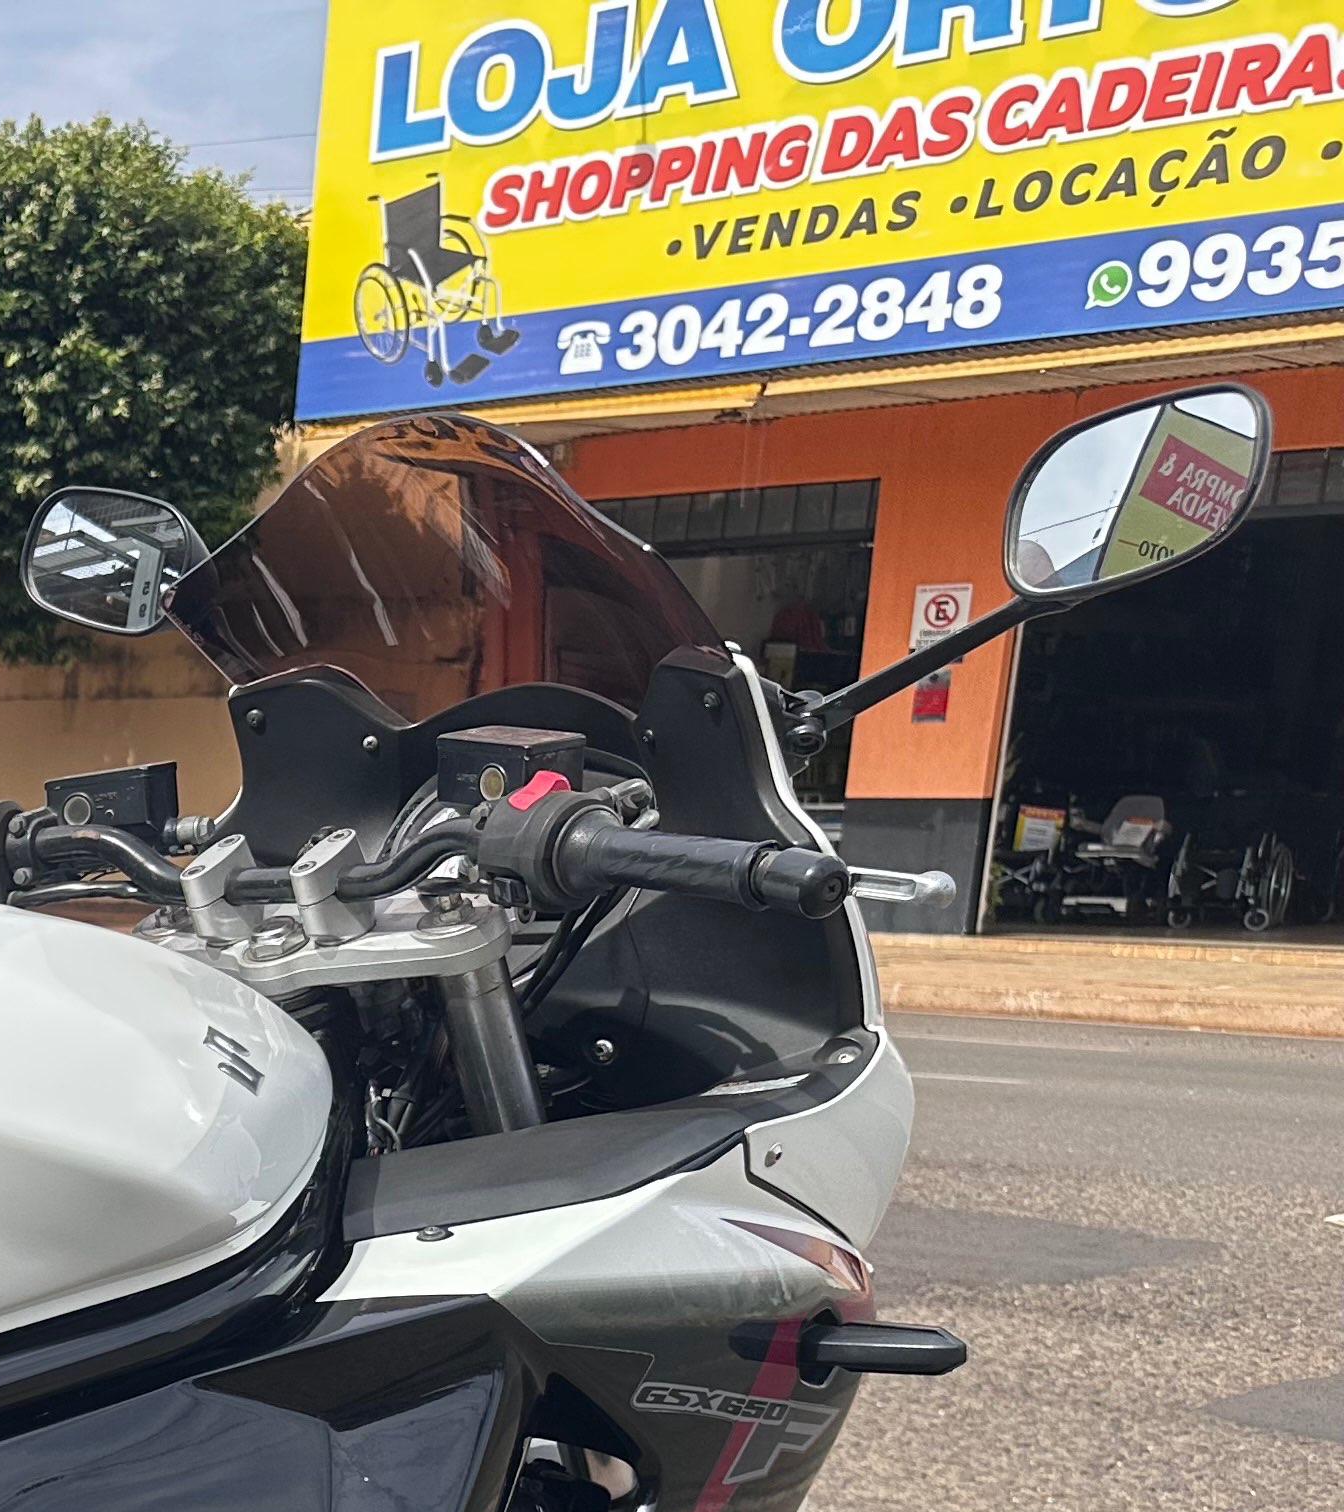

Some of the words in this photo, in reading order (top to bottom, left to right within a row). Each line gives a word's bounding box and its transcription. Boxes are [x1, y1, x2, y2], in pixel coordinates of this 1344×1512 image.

[373, 0, 732, 157] LOJA
[484, 123, 812, 229] SHOPPING
[821, 95, 973, 177] DAS
[986, 33, 1344, 146] CADEIRA
[693, 190, 919, 261] VENDAS
[973, 126, 1286, 221] LOCAÇÃO
[614, 262, 1004, 374] 3042-2848
[1135, 218, 1344, 309] 9935
